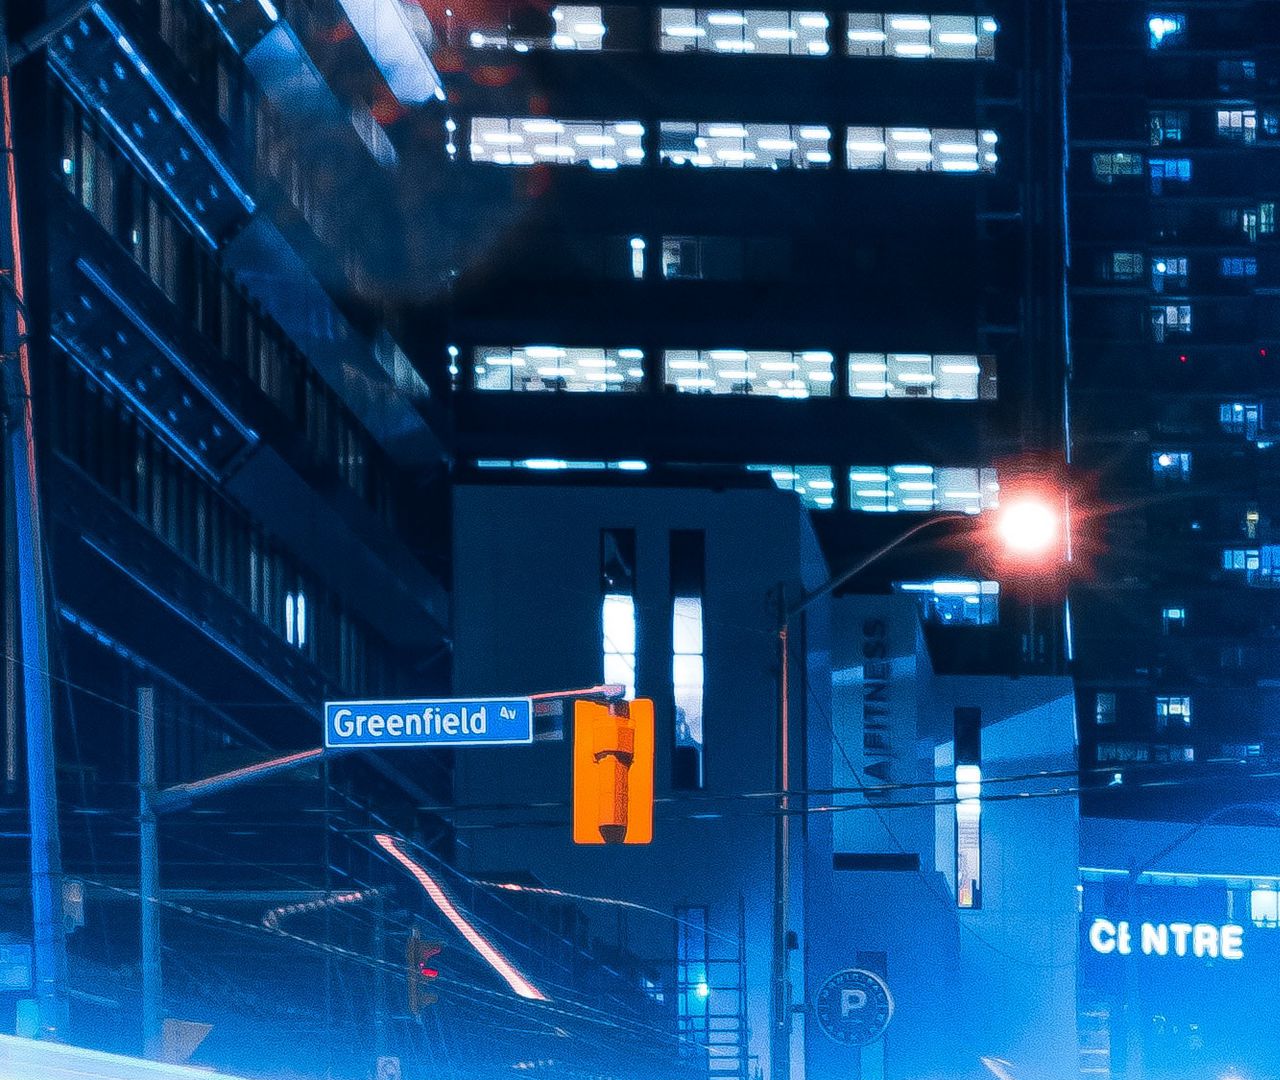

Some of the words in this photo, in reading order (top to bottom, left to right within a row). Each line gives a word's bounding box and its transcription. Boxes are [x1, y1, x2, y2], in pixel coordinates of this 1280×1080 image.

[863, 619, 888, 750] FITNESS
[334, 706, 487, 737] Greenfield
[499, 706, 517, 720] Av
[841, 989, 867, 1017] P
